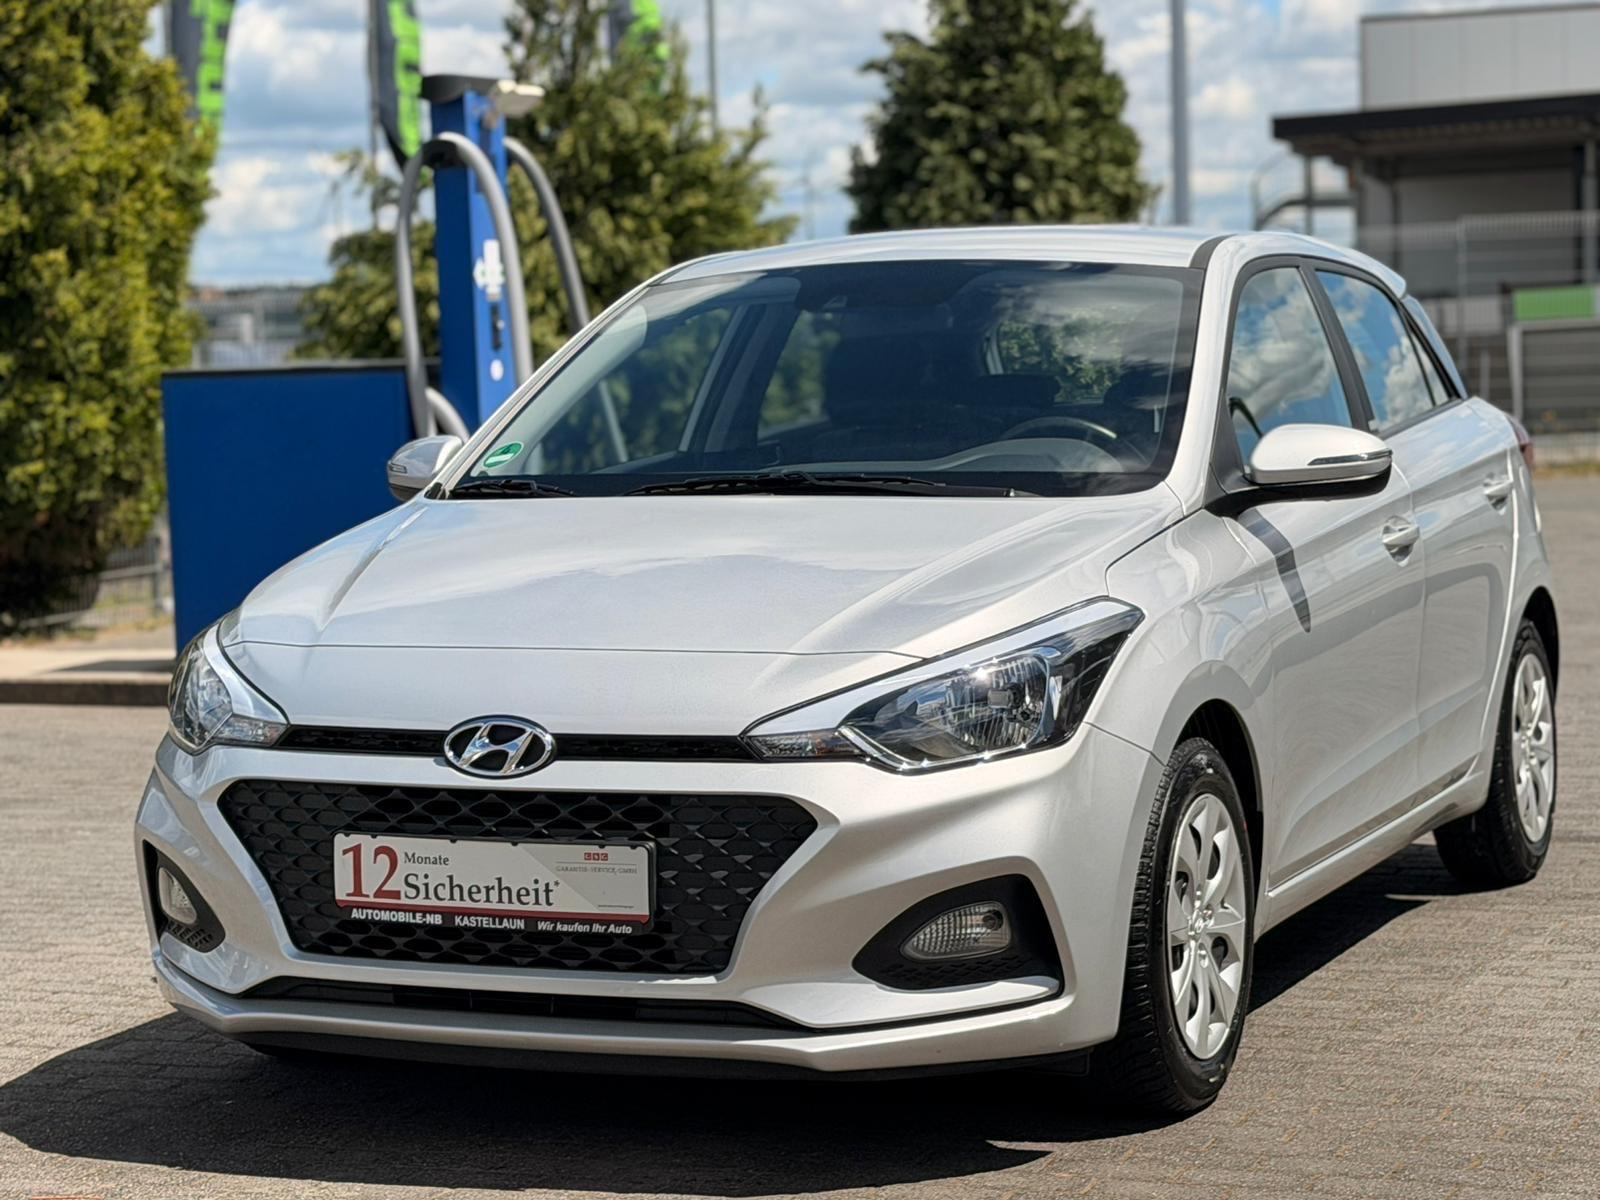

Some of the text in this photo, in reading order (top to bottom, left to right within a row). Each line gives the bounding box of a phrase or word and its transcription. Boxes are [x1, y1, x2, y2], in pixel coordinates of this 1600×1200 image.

[342, 842, 449, 900] 12 Monate
[350, 908, 633, 934] AUTOMOBILE-NB KASTELLAUN Wir kaufen Ihr Auto
